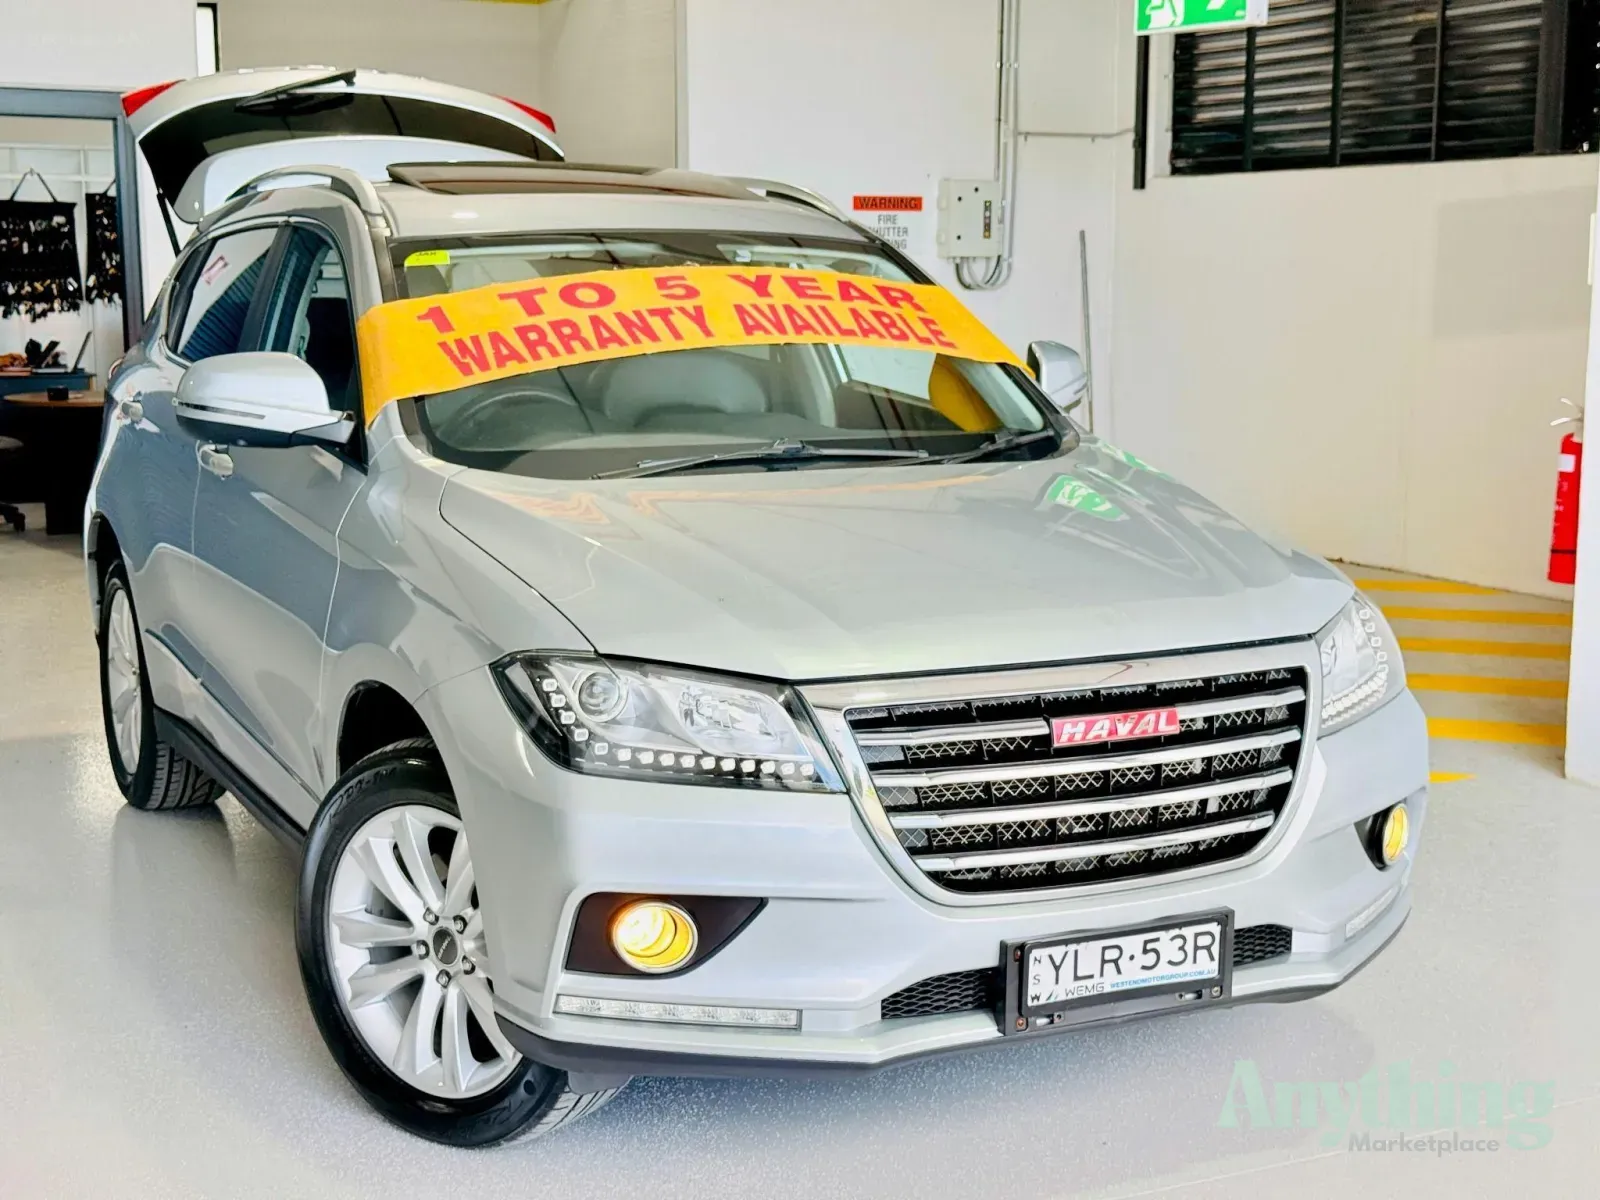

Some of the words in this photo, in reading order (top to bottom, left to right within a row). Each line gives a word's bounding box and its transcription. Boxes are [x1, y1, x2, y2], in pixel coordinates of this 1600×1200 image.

[860, 196, 917, 209] WARNING
[877, 214, 898, 225] FIRE
[417, 305, 455, 334] 1
[497, 281, 616, 317] TO
[654, 275, 701, 300] 5
[727, 274, 927, 313] YEAR
[437, 305, 714, 377] WARRANTY
[734, 303, 957, 349] AVAILABLE
[1059, 711, 1176, 743] HAVAL
[1064, 981, 1105, 998] WEMG
